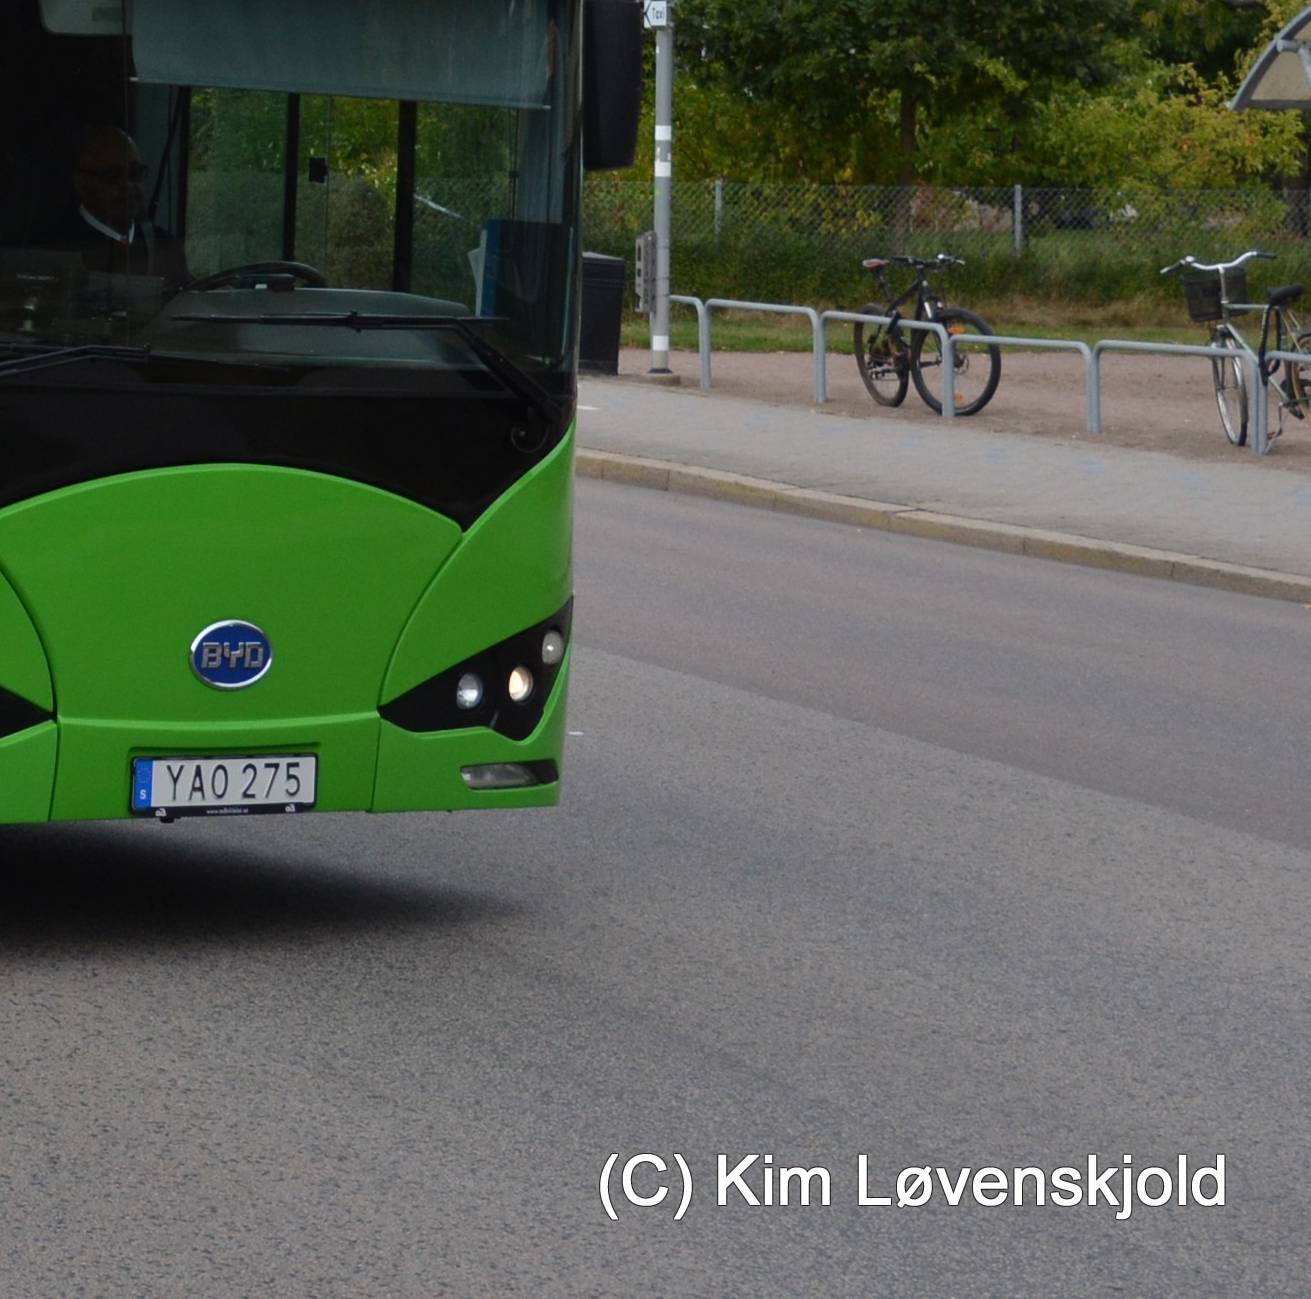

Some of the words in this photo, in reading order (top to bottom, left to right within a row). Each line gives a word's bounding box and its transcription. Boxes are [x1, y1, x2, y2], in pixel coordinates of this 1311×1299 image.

[652, 6, 665, 20] Taxi
[201, 641, 264, 669] BYD
[166, 764, 229, 801] YAO
[241, 762, 301, 799] 275
[139, 789, 147, 800] S
